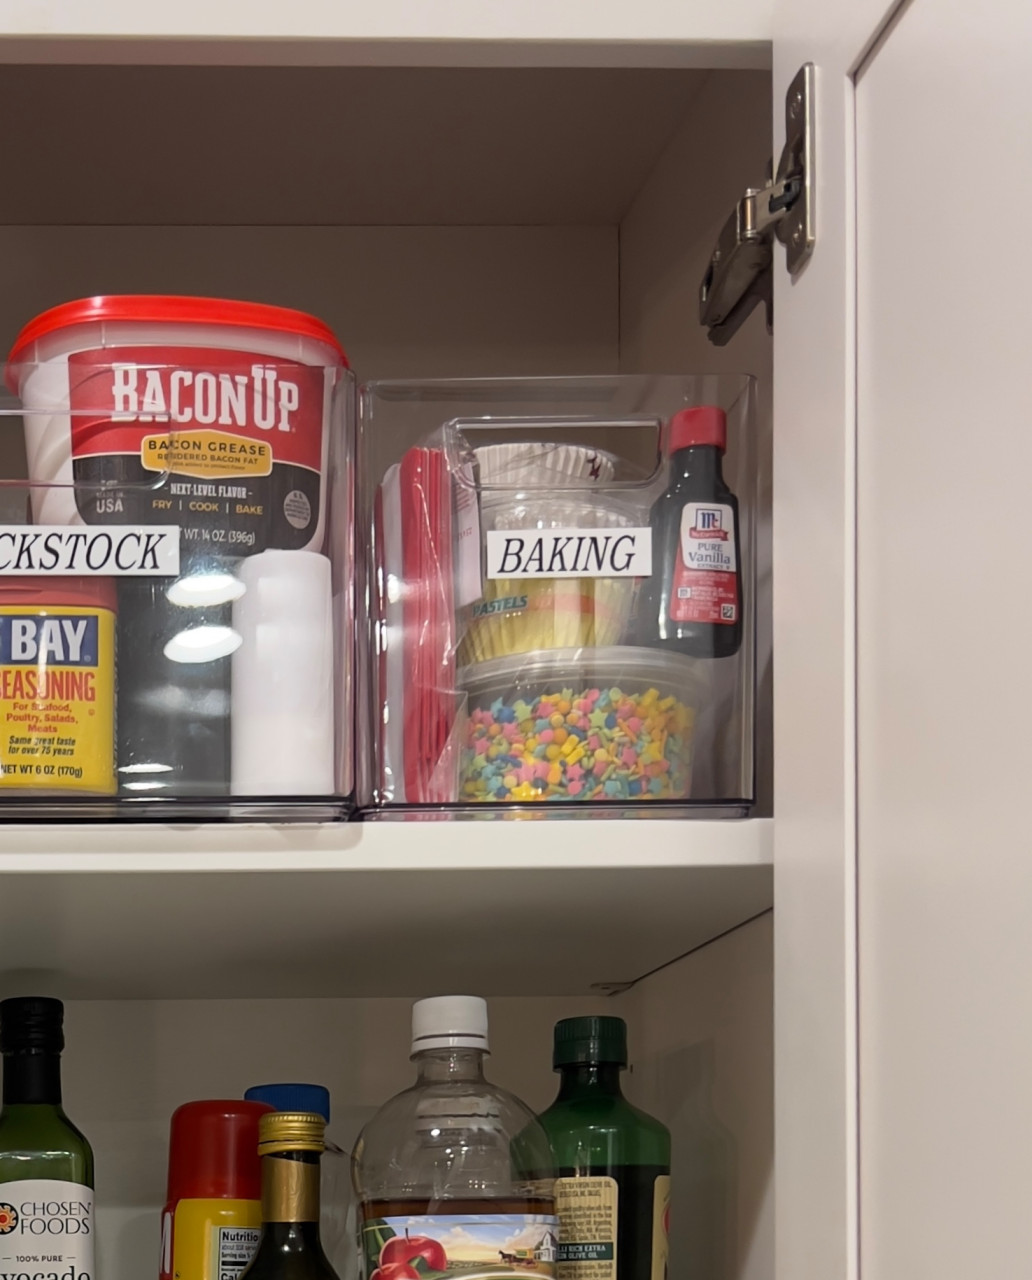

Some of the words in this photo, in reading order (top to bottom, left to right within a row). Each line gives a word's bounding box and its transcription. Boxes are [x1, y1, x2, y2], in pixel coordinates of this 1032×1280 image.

[148, 440, 202, 452] BACON
[207, 441, 266, 457] GREASE
[209, 454, 241, 464] BACON
[243, 456, 259, 465] FAT
[218, 483, 247, 499] FLAVOR
[96, 499, 123, 514] USA
[152, 500, 172, 510] FRY
[189, 501, 219, 512] COOK
[235, 503, 263, 515] BAKE
[228, 530, 255, 545] (396g)
[497, 534, 636, 575] BAKING
[697, 542, 724, 552] PURE
[688, 552, 731, 564] Vanilla
[472, 595, 528, 617] PASTELS
[11, 619, 88, 663] BAY
[13, 702, 29, 712] For
[28, 724, 58, 734] Meats
[9, 735, 32, 746] Same
[34, 736, 55, 748] great
[57, 736, 76, 746] taste
[52, 747, 75, 757] years
[1, 764, 19, 775] NET
[20, 765, 34, 775] WT
[43, 765, 56, 775] OZ
[57, 765, 83, 778] (170g)
[20, 1201, 90, 1216] CHOSEN
[20, 1217, 90, 1236] FOODS
[15, 1255, 40, 1263] 100%
